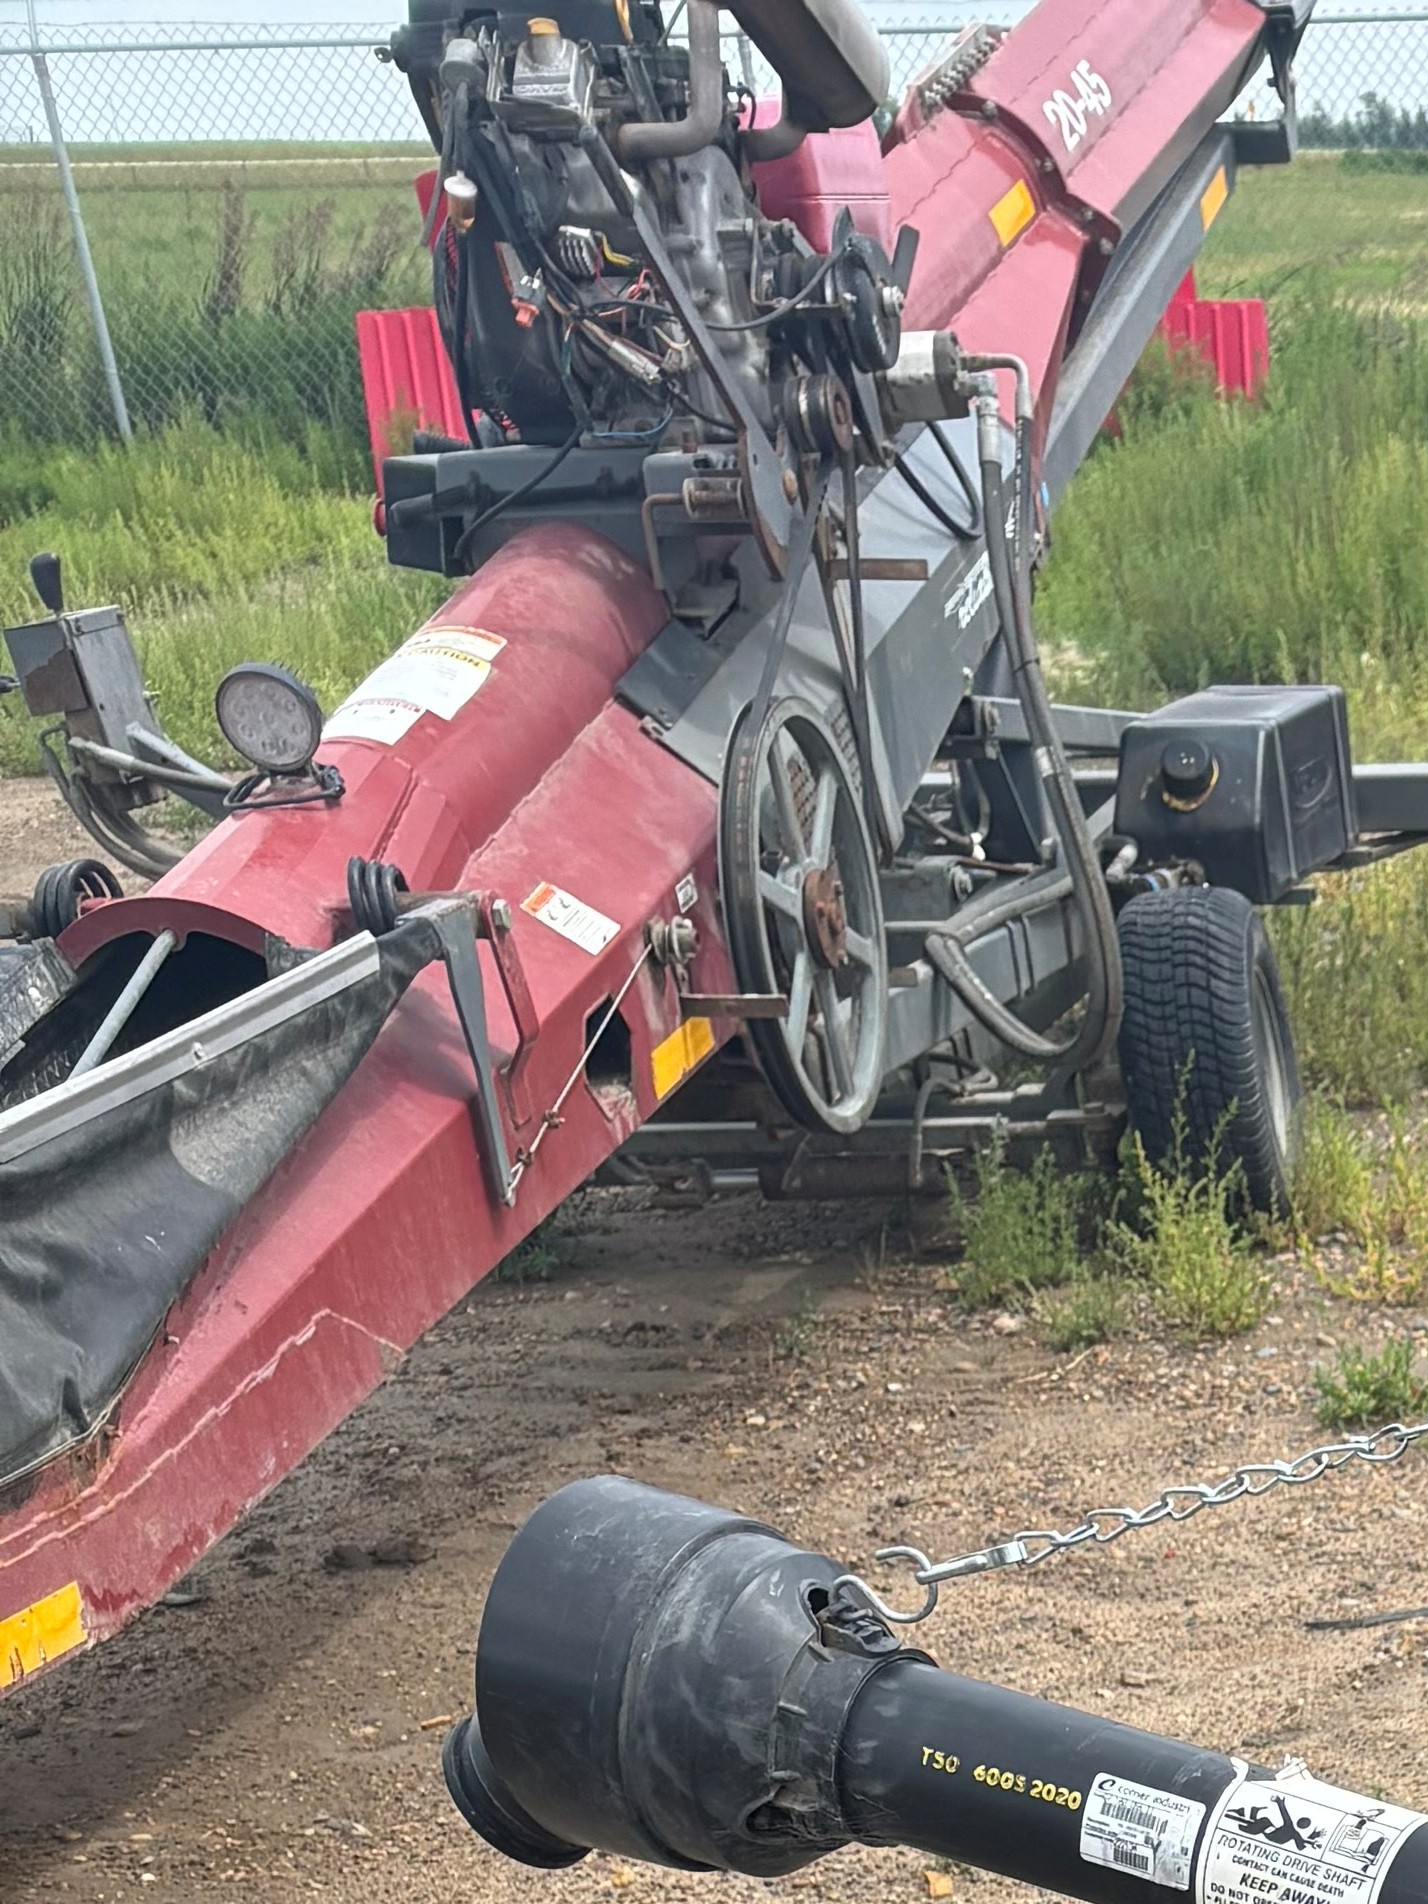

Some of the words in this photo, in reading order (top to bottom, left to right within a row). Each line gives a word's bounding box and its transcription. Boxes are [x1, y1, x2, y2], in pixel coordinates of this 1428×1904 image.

[1043, 59, 1111, 151] 20-45
[1029, 1780, 1082, 1810] 2020
[1217, 1832, 1280, 1864] ROTATING
[1282, 1853, 1322, 1878] DRIVE
[1322, 1866, 1366, 1892] SHAFT
[1231, 1854, 1269, 1874] CONTACT
[1210, 1881, 1225, 1895] DO
[1227, 1887, 1250, 1903] NOT
[1238, 1870, 1278, 1897] KEEP
